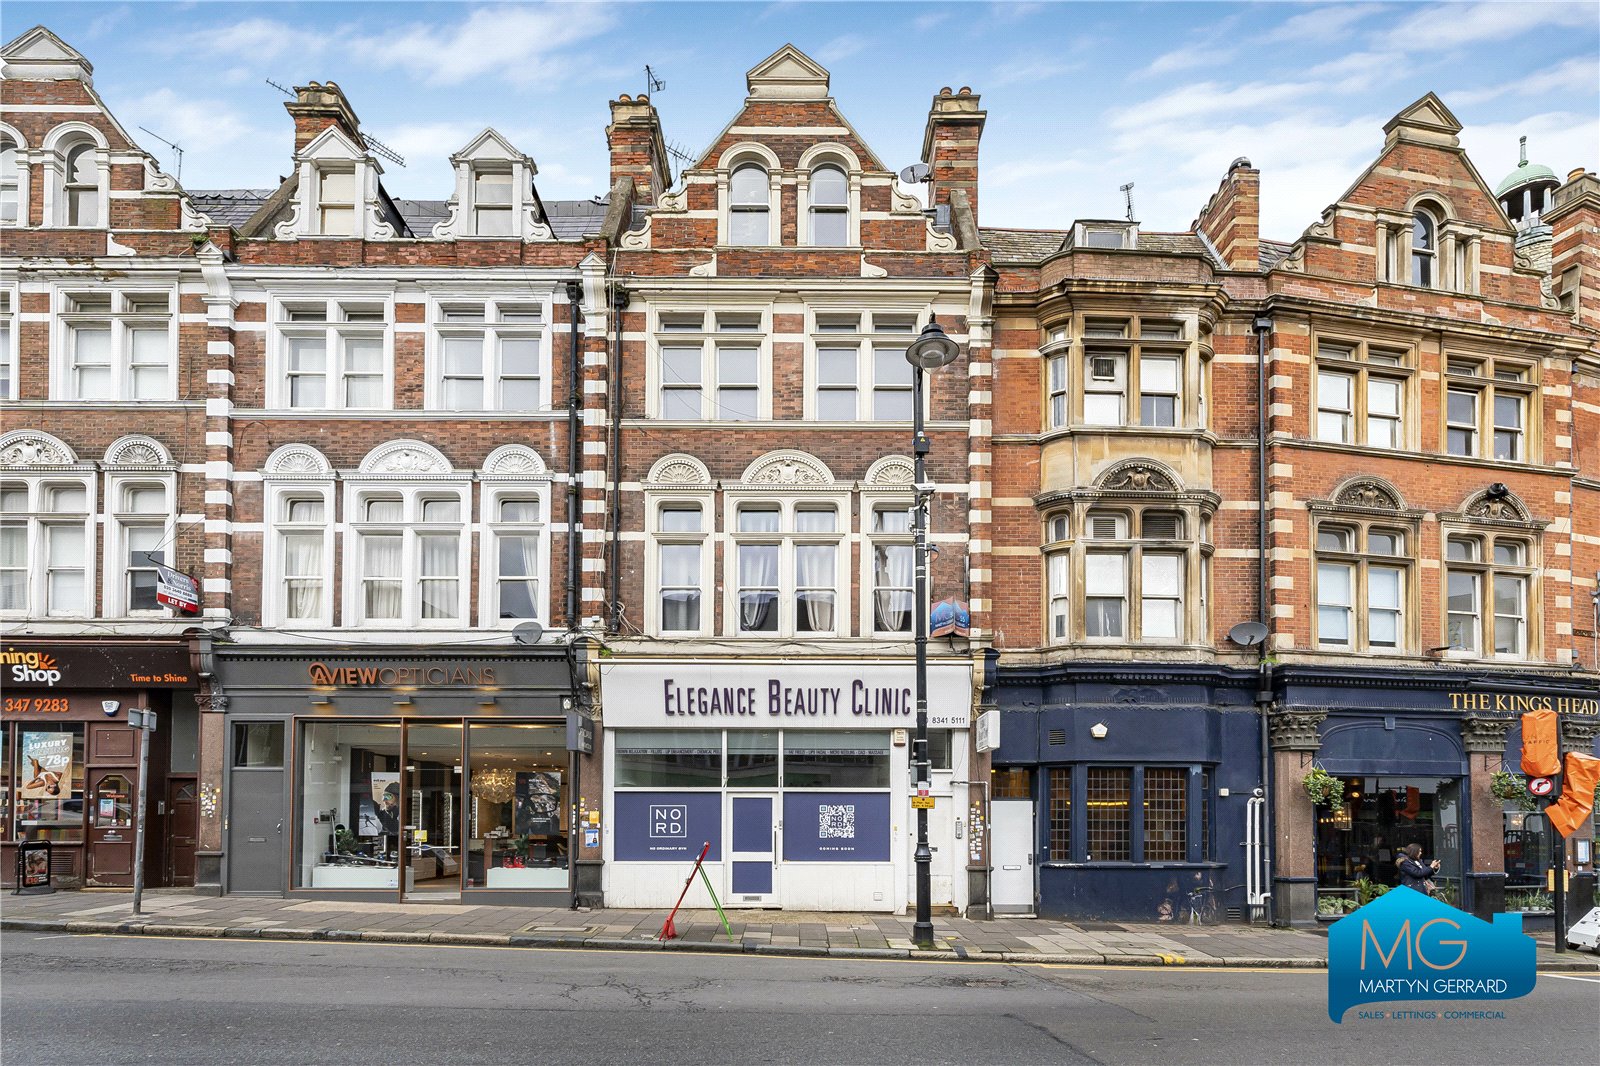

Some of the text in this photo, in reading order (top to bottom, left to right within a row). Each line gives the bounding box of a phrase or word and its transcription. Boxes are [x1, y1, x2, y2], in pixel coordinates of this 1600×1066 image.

[12, 664, 61, 686] Shop
[130, 674, 151, 682] Time
[164, 673, 188, 682] Shine
[4, 698, 70, 712] 347 9283
[664, 678, 912, 716] ELEGANCE BEAUTY CLINIC
[1448, 692, 1598, 716] THE KINGS HEAD
[29, 739, 68, 750] LUXURY
